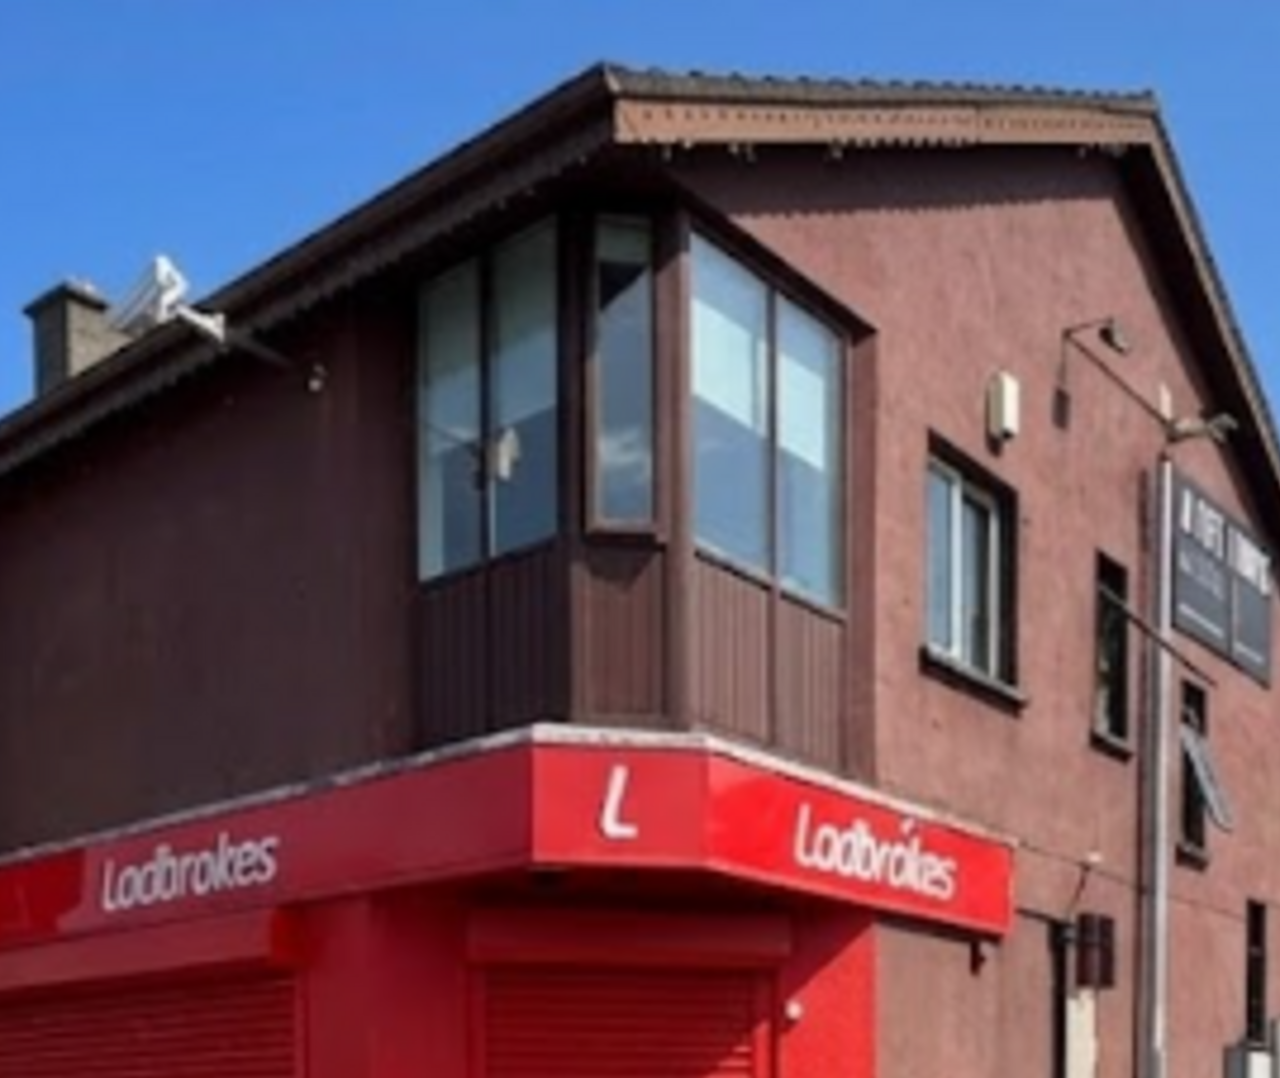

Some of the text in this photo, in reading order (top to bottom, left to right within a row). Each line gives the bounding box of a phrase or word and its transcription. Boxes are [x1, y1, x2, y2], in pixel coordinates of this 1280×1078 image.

[601, 766, 637, 838] L
[103, 833, 278, 910] Ladbrokes
[795, 804, 956, 899] Ladbrokes
